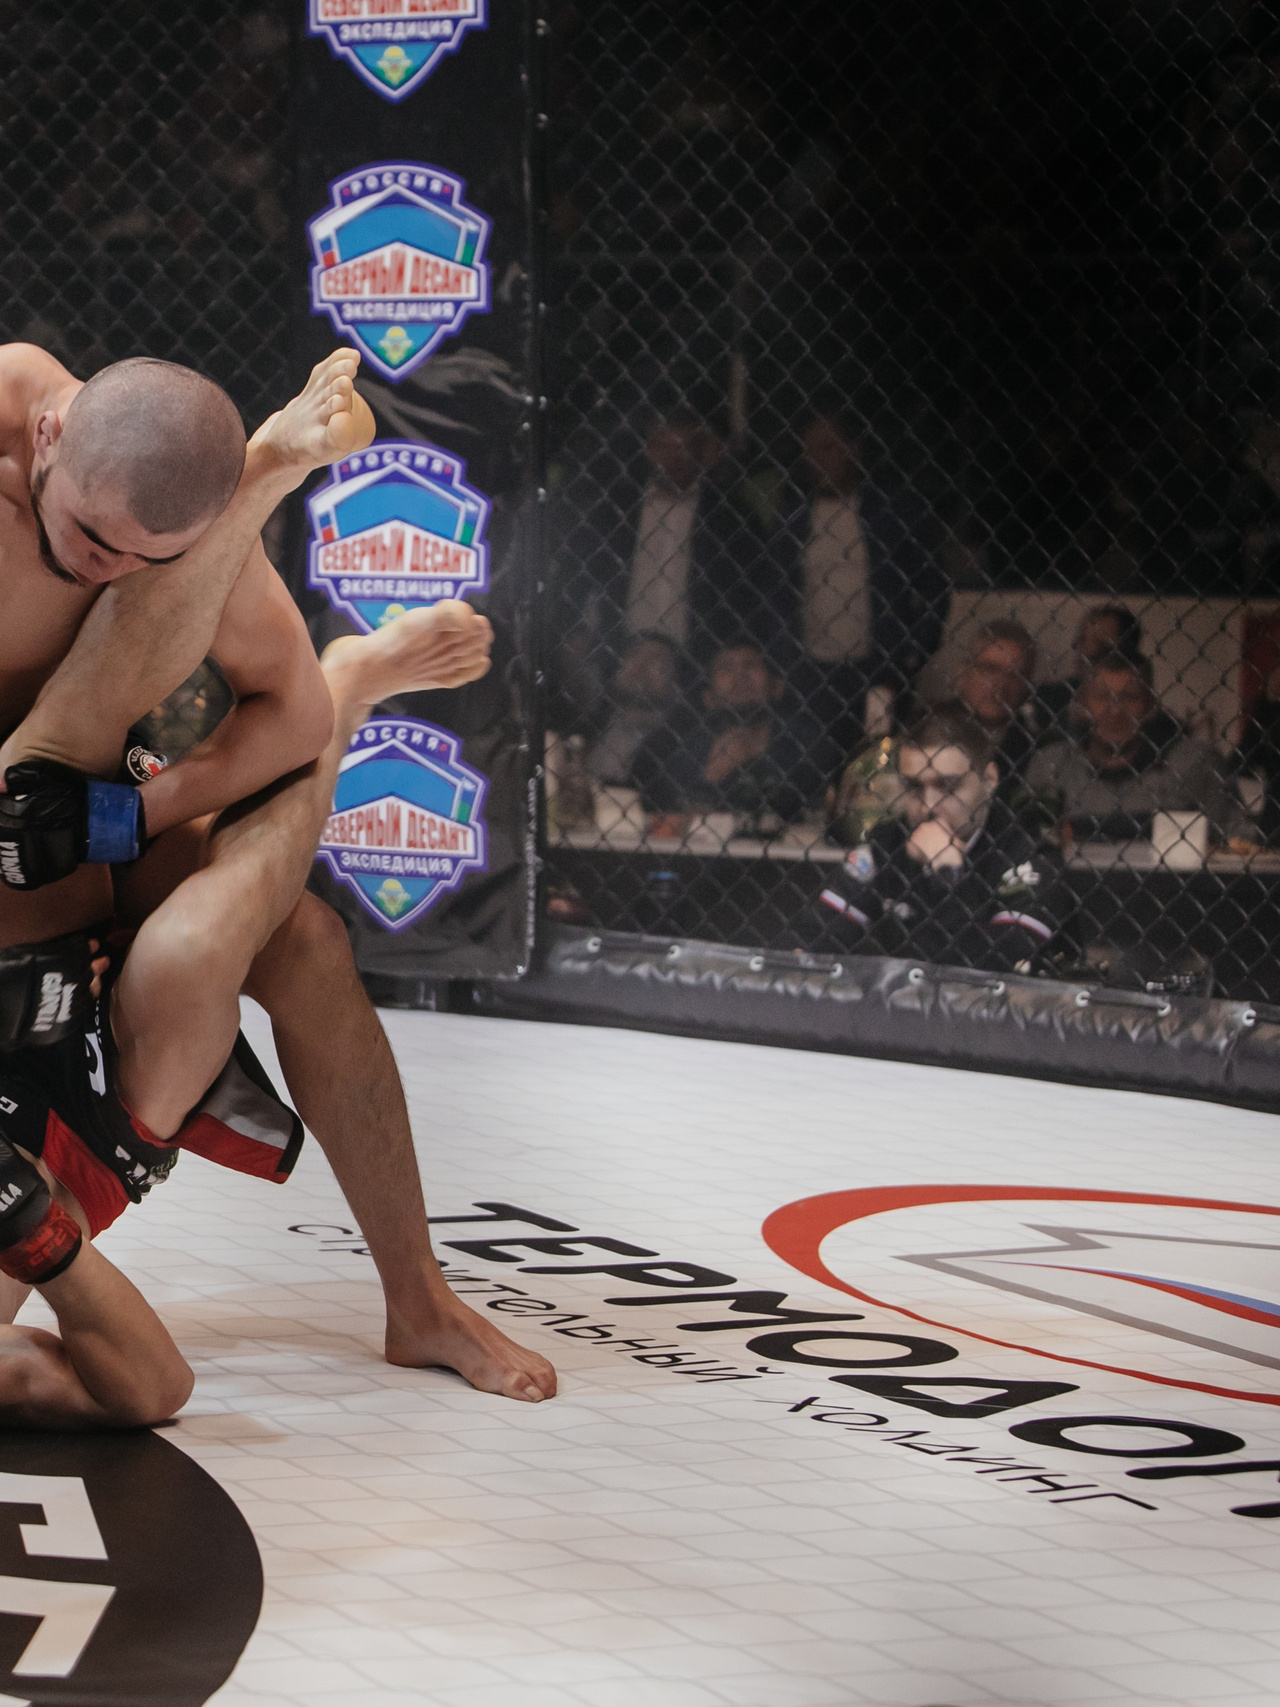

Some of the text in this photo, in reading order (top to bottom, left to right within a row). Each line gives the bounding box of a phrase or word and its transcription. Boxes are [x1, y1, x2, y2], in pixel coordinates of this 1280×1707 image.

[351, 171, 442, 195] РОССИЯ
[324, 249, 472, 295] СЕВЕРНЫЙ ДЕСАНТ
[341, 301, 455, 322] ЭКСПЕДИЦИЯ
[349, 450, 443, 474] РОССИЯ
[322, 527, 471, 574] СЕВЕРНЫЙ ДЕСАНТ
[339, 578, 454, 597] ЭКСПЕДИЦИЯ
[350, 726, 439, 751] РОССИЯ
[322, 802, 468, 851] СЕВЕРНЫЙ ДЕСАНТ
[341, 852, 453, 876] ЭКСПЕДИЦИЯ
